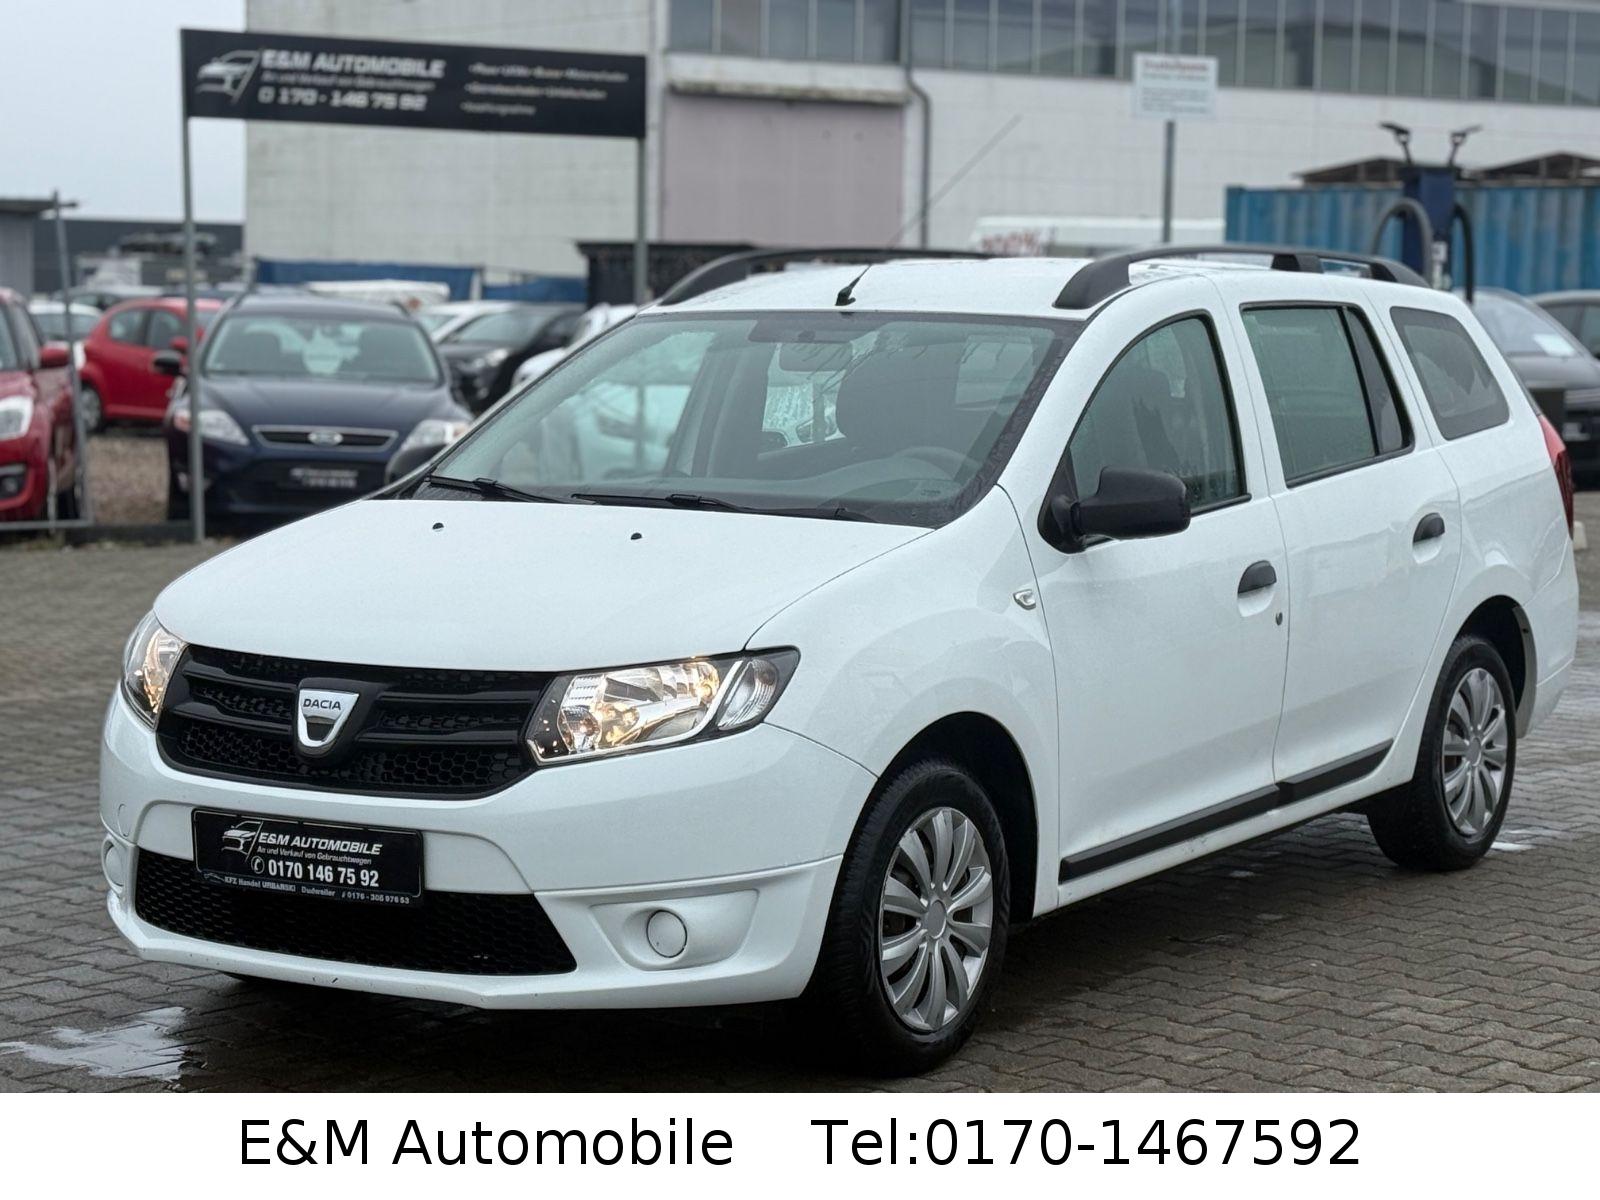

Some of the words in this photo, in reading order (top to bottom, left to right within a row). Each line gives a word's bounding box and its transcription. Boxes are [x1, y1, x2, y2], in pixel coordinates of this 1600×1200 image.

[261, 49, 311, 70] E&M
[312, 52, 446, 78] AUTOMOBILE
[303, 698, 341, 711] DACIA
[258, 832, 290, 846] E&M
[290, 836, 383, 855] AUTOMOBILE
[257, 845, 266, 853] An
[267, 847, 279, 856] und
[279, 848, 304, 859] Verkauf
[304, 851, 316, 860] von
[316, 852, 372, 866] Gebrauchtwagen
[268, 859, 303, 879] 0170
[307, 863, 334, 883] 146
[337, 866, 356, 885] 75
[360, 869, 380, 887] 92
